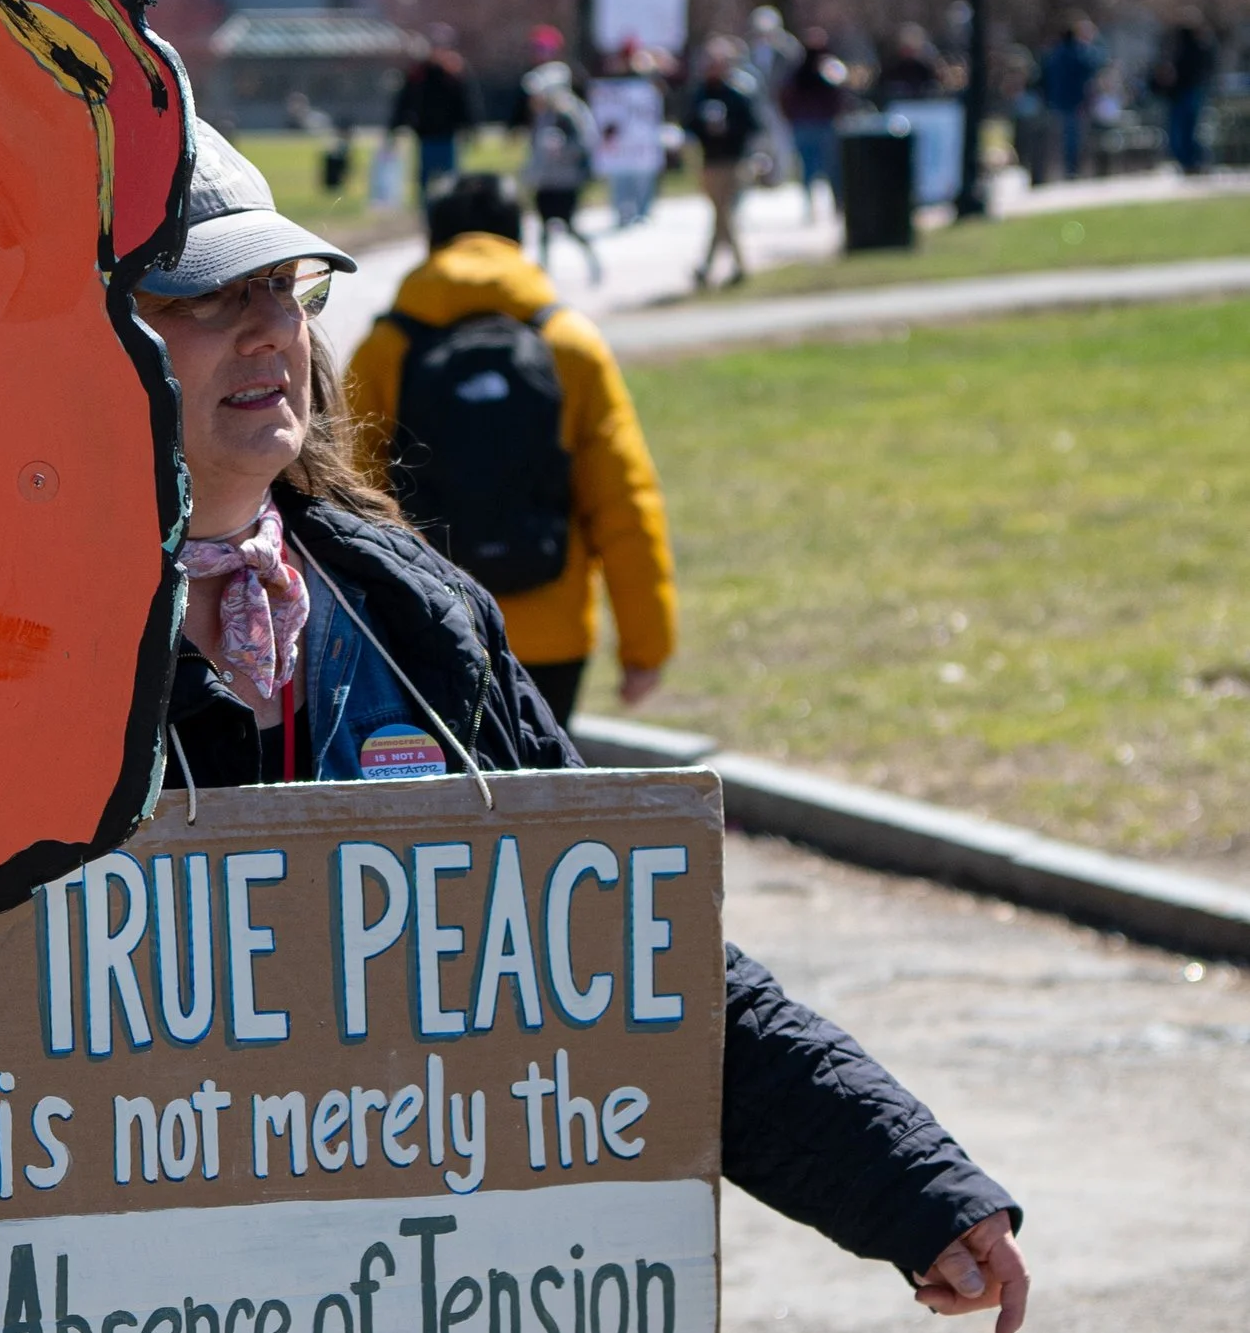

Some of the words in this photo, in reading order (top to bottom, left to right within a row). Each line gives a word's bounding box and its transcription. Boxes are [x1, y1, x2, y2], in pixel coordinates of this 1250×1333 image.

[371, 738, 427, 747] democracy
[374, 754, 386, 763] IS
[391, 752, 415, 761] NOT
[417, 751, 425, 760] A
[368, 764, 442, 778] SPECTATOR
[32, 849, 291, 1059] TRUE
[338, 834, 688, 1039] PEACE
[114, 1079, 231, 1186] not
[251, 1053, 486, 1195] merely
[510, 1048, 650, 1171] the
